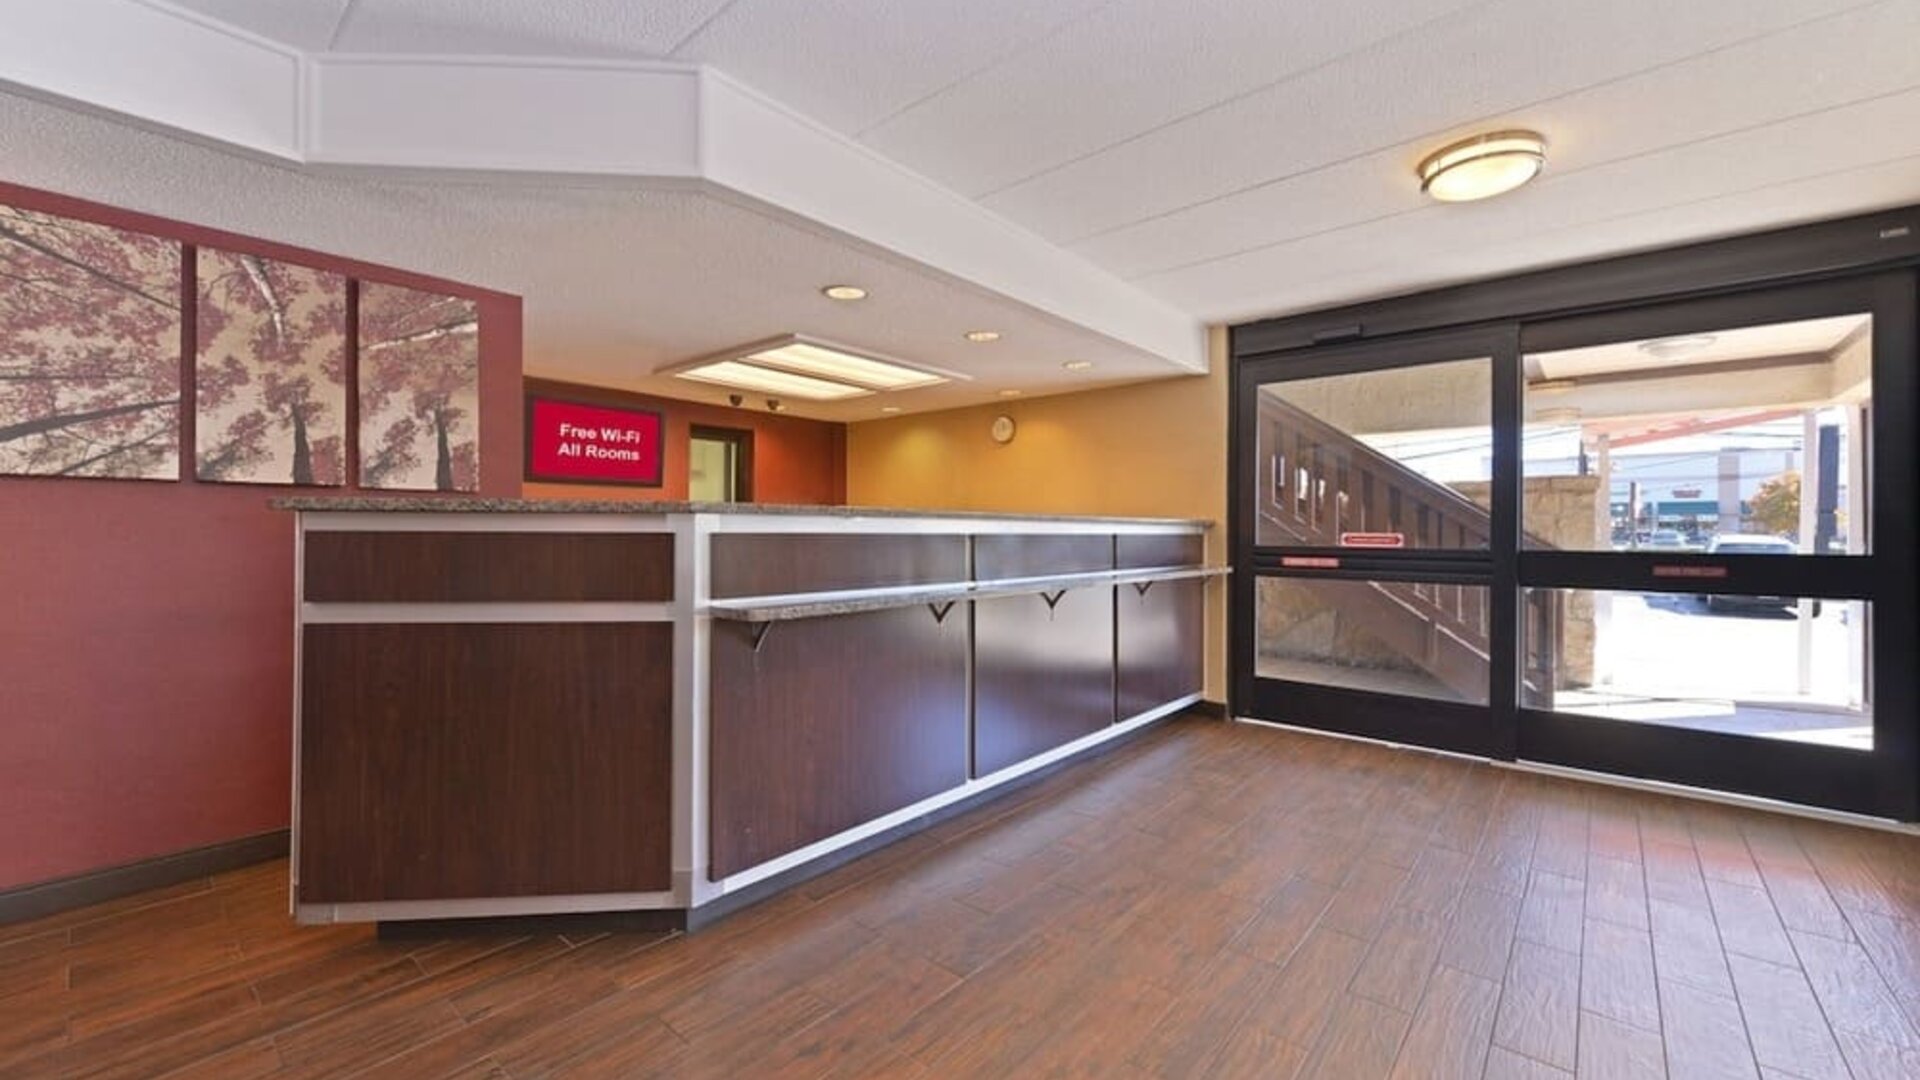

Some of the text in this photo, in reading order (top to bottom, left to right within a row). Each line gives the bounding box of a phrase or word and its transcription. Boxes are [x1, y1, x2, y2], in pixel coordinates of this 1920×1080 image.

[559, 423, 641, 444] Free Wi-Fi
[557, 442, 640, 461] All Rooms
